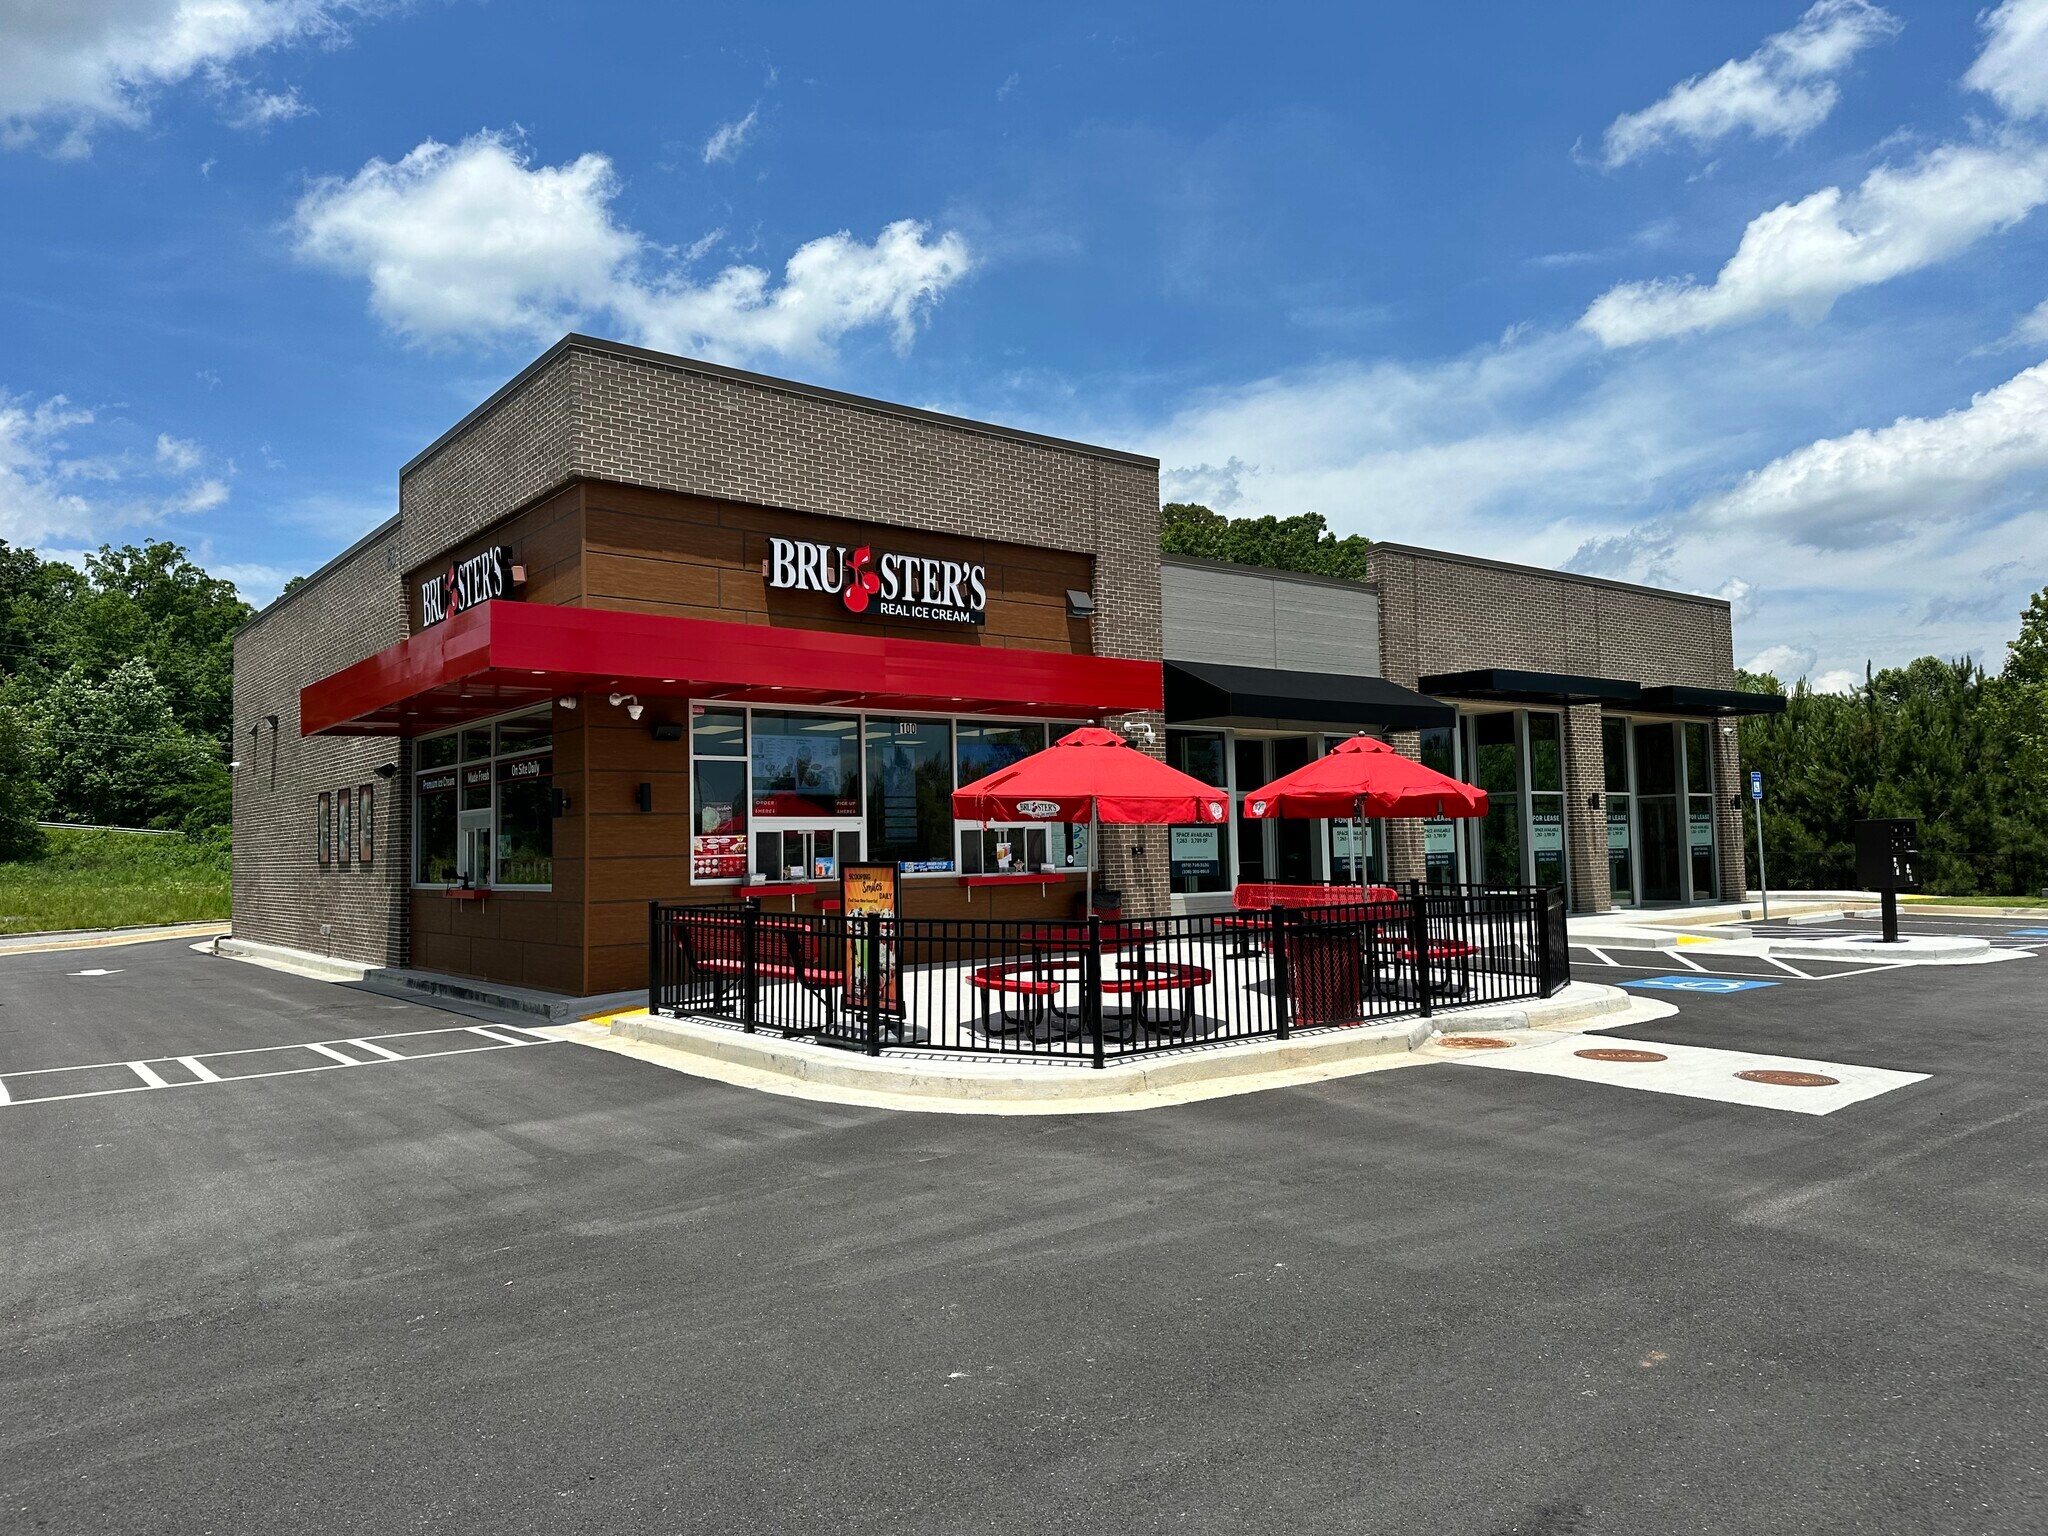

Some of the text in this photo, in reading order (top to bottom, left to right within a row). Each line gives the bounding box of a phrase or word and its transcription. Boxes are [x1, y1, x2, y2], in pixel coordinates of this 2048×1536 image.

[880, 603, 971, 623] REAL ICE CREAM
[467, 769, 490, 784] Made Fresh
[511, 760, 540, 777] On Site Daily
[862, 878, 882, 893] Smiles
